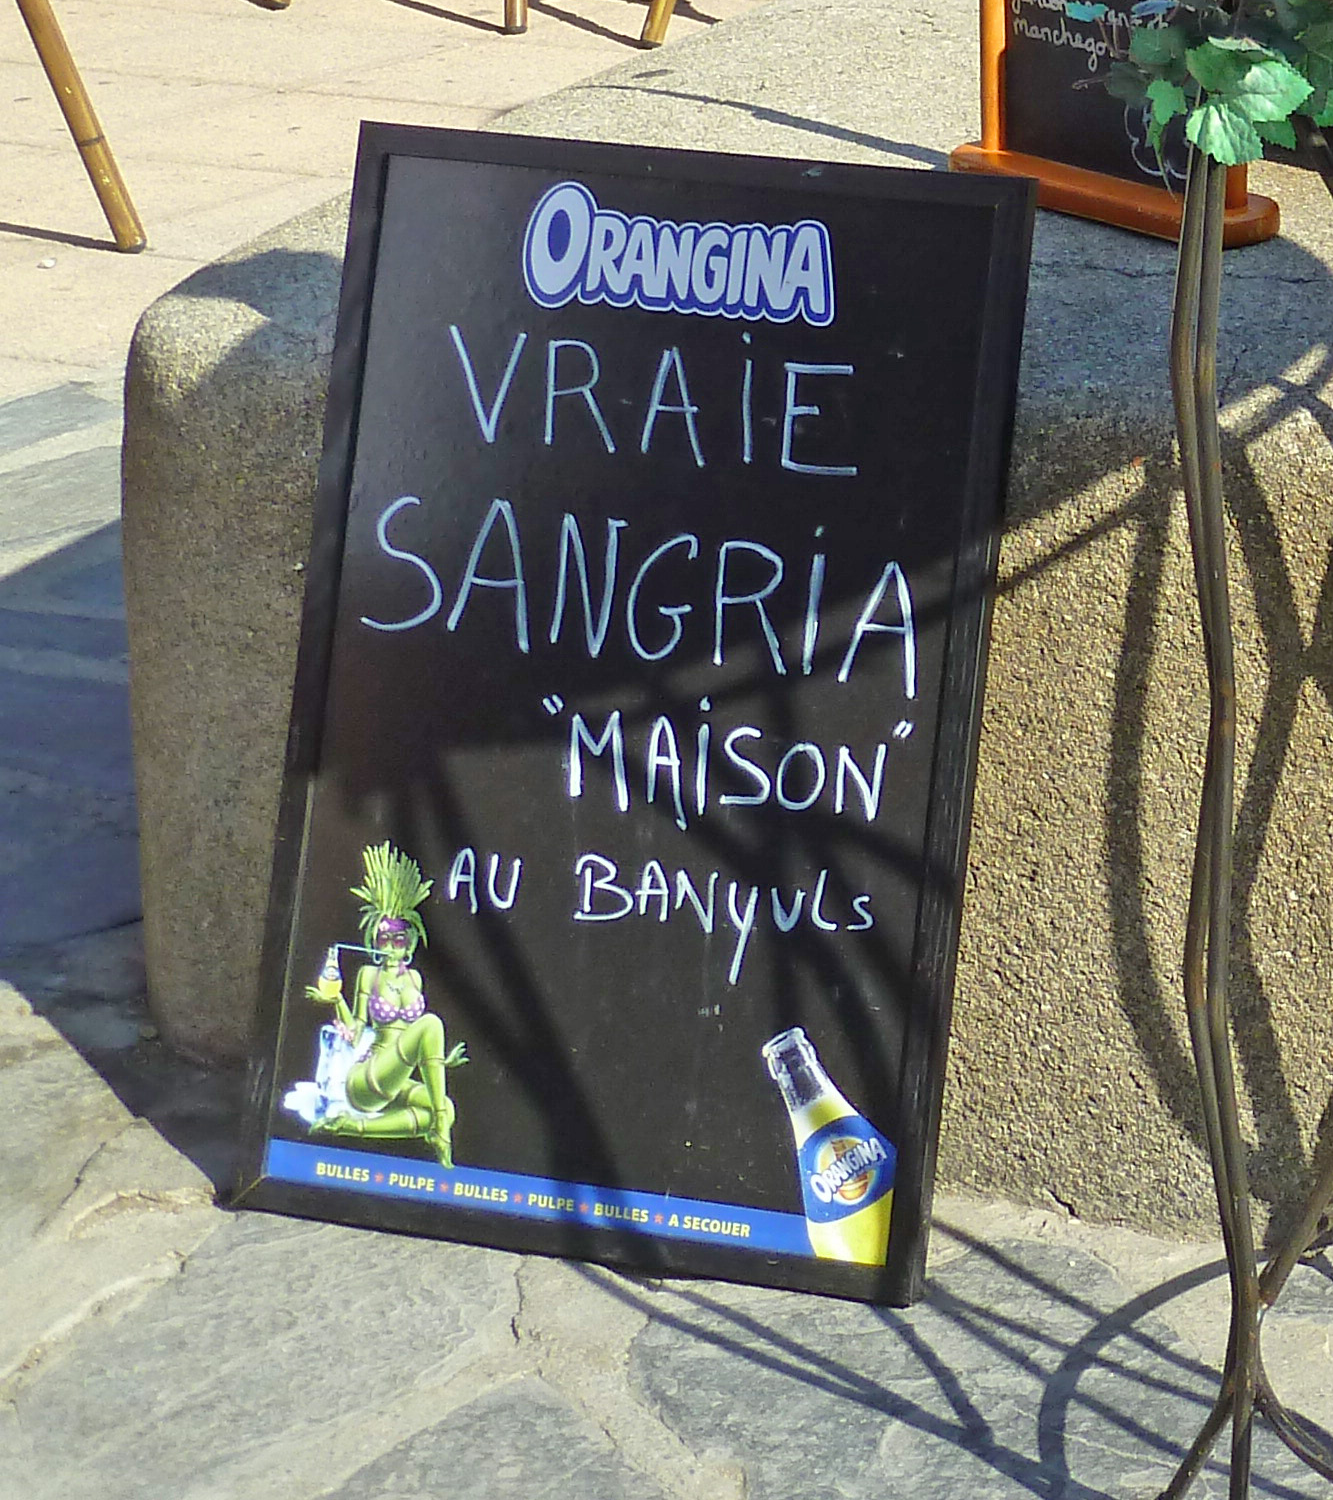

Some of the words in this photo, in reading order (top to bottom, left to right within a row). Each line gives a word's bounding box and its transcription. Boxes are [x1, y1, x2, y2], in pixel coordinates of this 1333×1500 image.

[524, 182, 834, 326] ORANGINA
[447, 846, 523, 913] AU
[315, 1161, 371, 1183] BULLES
[388, 1172, 436, 1193] PULPE
[453, 1182, 509, 1203] BULLES
[527, 1192, 575, 1213] PULPE
[593, 1202, 650, 1224] BULLES
[668, 1213, 680, 1228] A
[682, 1214, 752, 1239] SECOUER
[810, 1137, 888, 1204] ORANGINA
